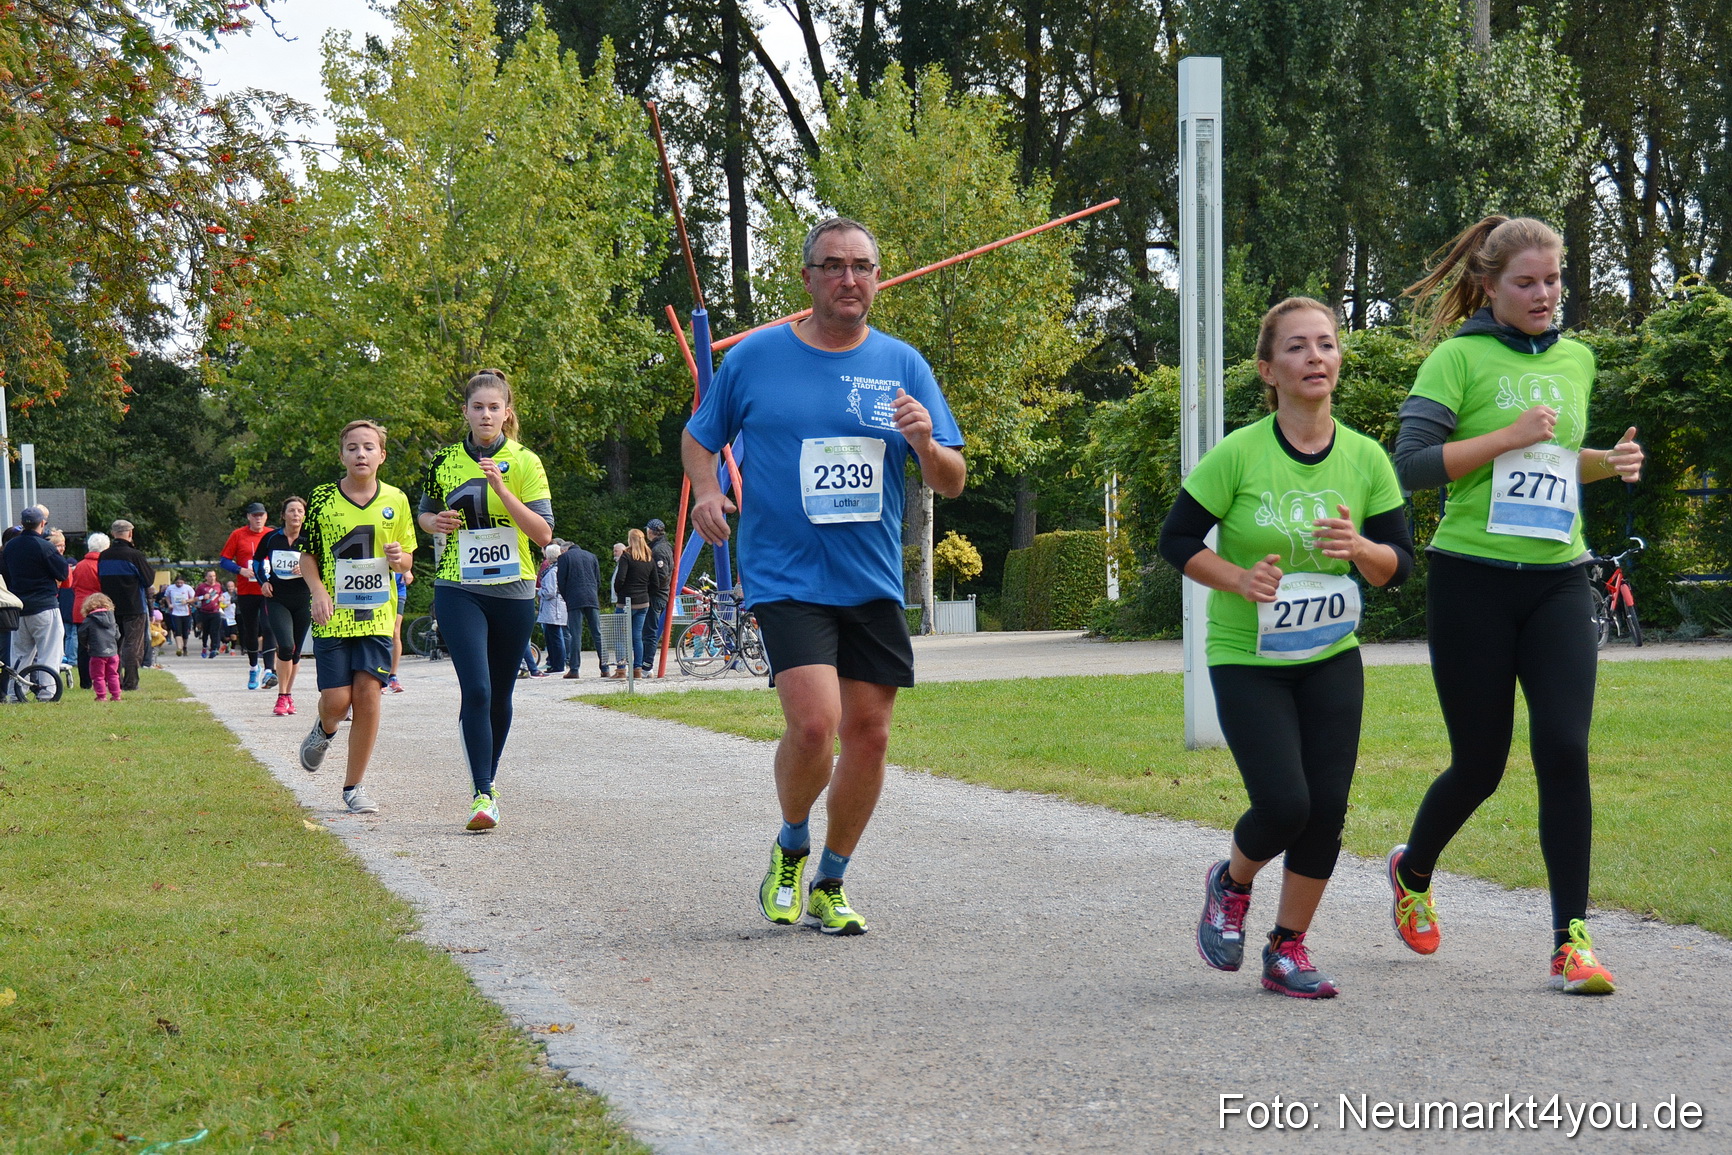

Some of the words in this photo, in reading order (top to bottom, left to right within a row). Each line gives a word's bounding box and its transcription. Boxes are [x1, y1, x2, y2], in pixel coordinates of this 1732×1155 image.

[852, 382, 892, 391] STADTLAUF
[853, 376, 900, 387] NEUMARKTER
[813, 463, 873, 490] 2339
[833, 498, 860, 508] Lothar
[468, 544, 510, 564] 2660
[276, 559, 298, 568] 2148
[344, 574, 383, 590] 2688
[1273, 592, 1345, 629] 2770
